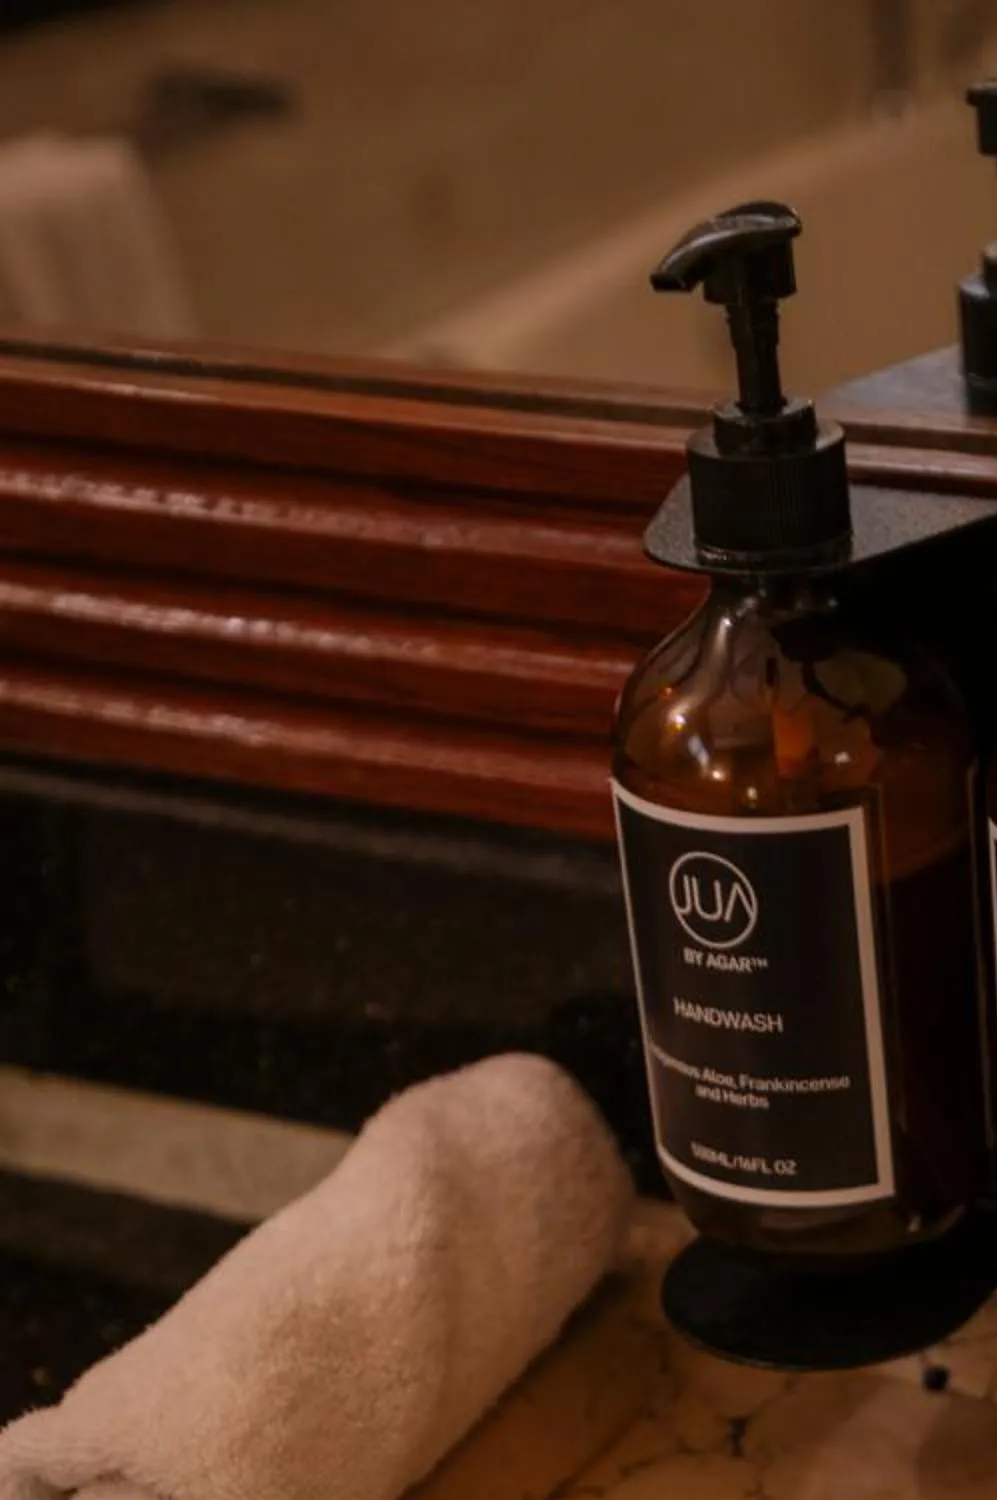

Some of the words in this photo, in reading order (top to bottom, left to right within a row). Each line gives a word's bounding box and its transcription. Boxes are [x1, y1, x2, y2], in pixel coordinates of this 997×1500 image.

[676, 874, 754, 922] JUA
[683, 947, 703, 966] BY
[674, 998, 783, 1034] HANDWASH
[739, 1073, 851, 1093] Frankincense
[695, 1083, 721, 1102] and
[723, 1089, 770, 1110] Herbs
[774, 1159, 797, 1175] OZ
